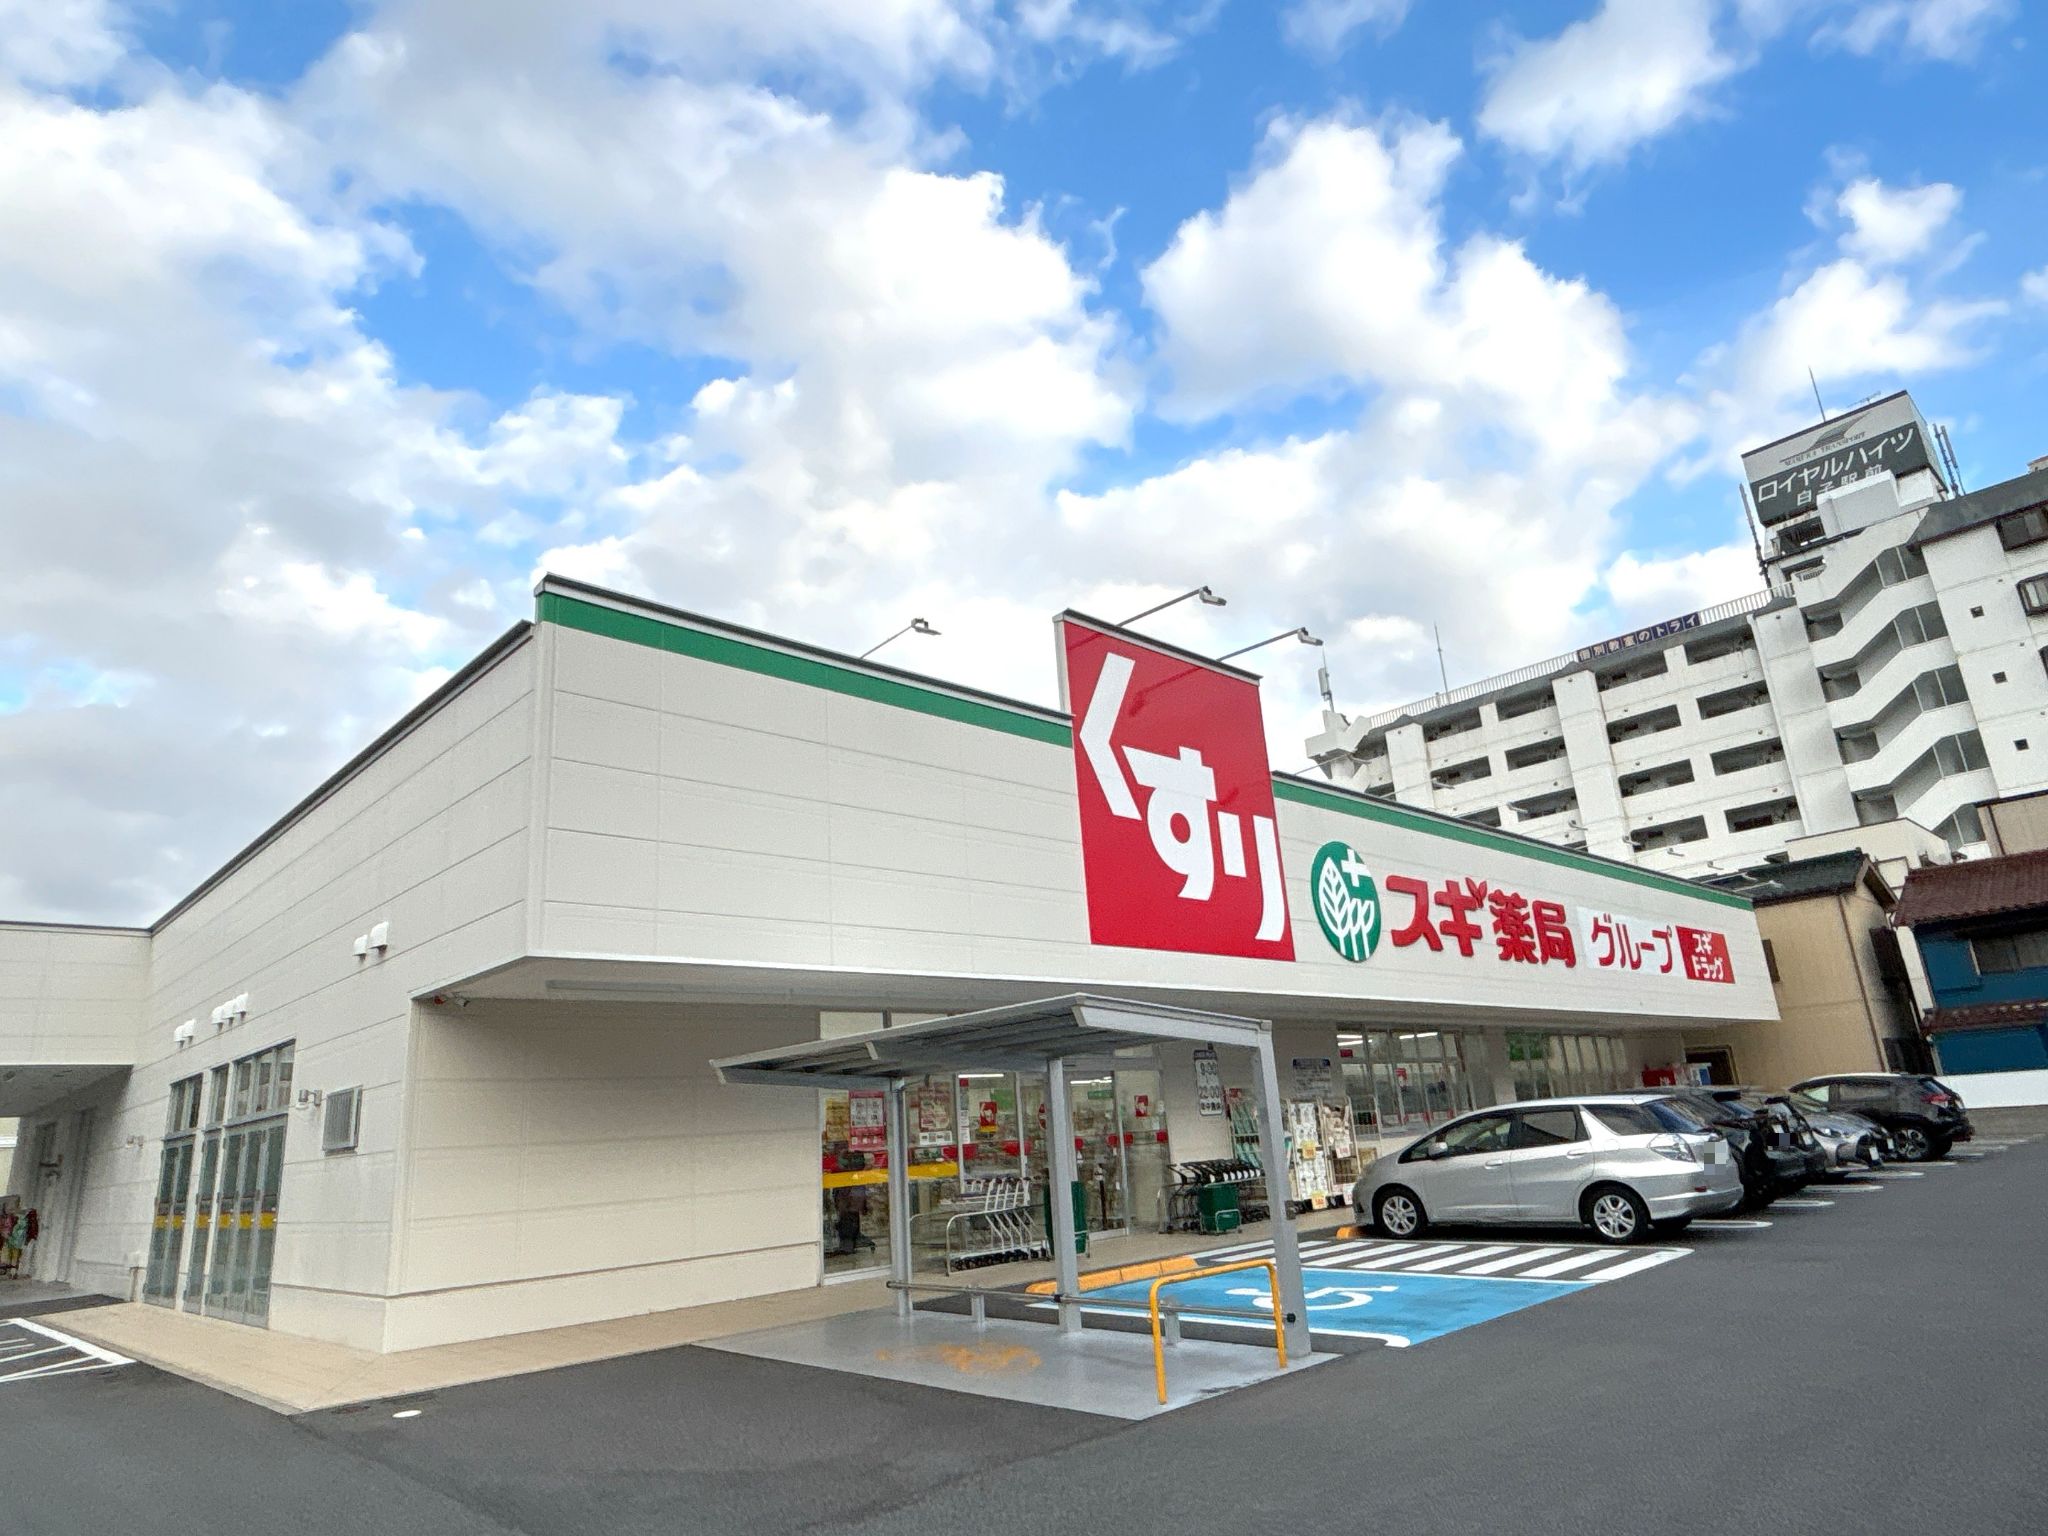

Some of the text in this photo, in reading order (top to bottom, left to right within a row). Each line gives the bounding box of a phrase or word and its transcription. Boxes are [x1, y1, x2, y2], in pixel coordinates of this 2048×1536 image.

[1758, 428, 1914, 503] ロイヤルハイツ
[1079, 652, 1285, 942] くすり
[1386, 874, 1673, 974] スギ薬局 グループ
[1691, 933, 1712, 955] スギ
[1691, 955, 1724, 980] ドラッグ
